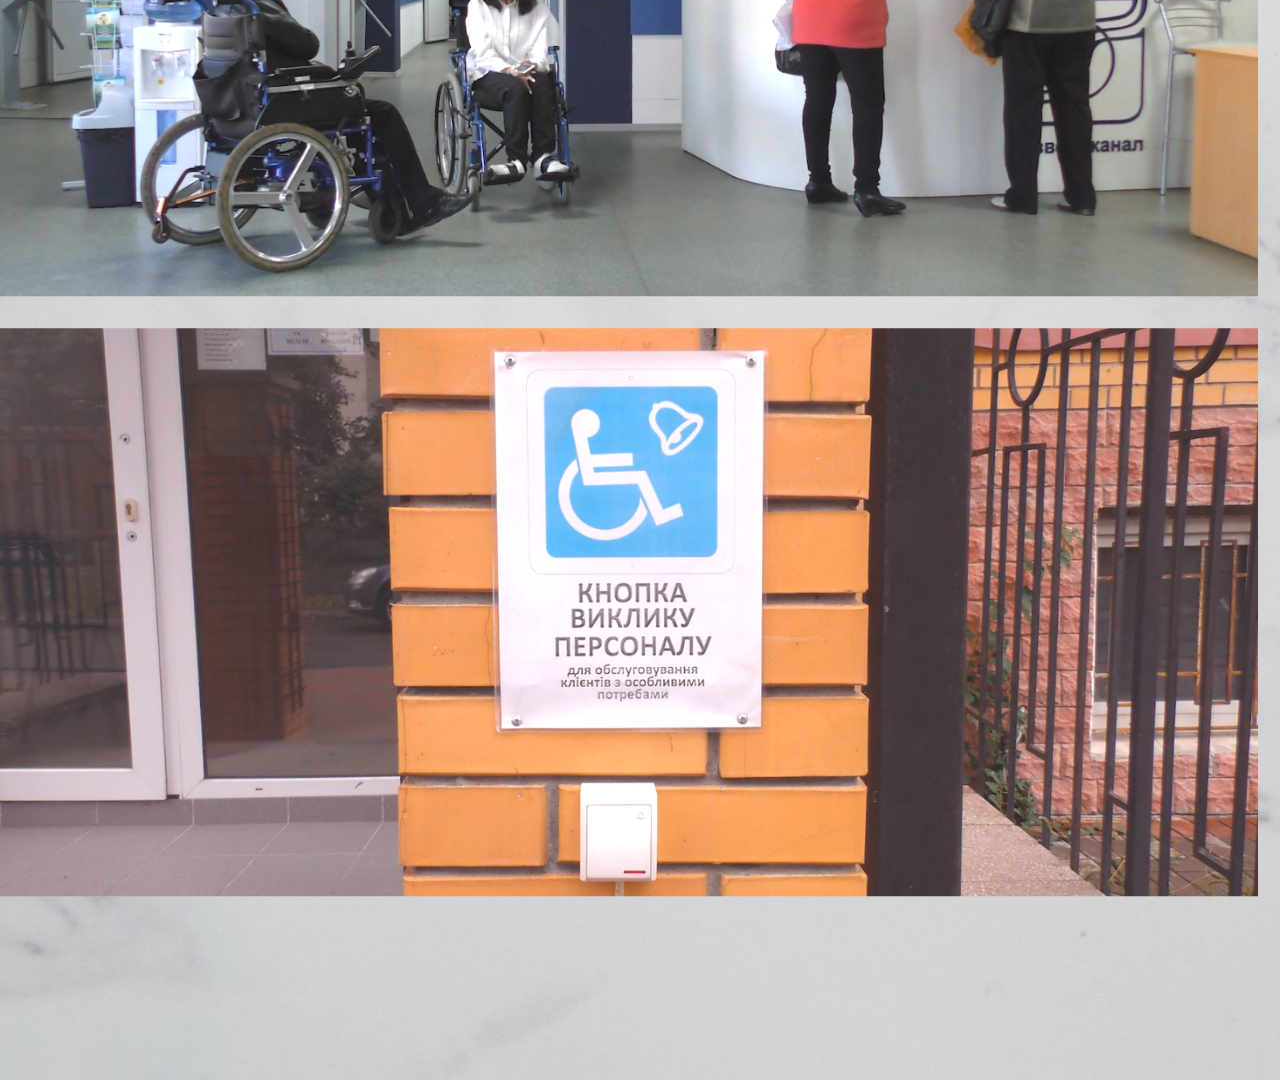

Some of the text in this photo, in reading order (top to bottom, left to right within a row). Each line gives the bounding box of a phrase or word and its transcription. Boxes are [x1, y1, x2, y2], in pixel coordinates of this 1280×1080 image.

[578, 582, 688, 603] КНОПКА
[571, 607, 695, 628] ВИКЛИКУ
[555, 635, 712, 657] ПЕРСОНАЛУ
[567, 664, 698, 677] для обслуговування
[560, 676, 705, 687] клієнтів з особливими
[597, 689, 669, 701] потребами
